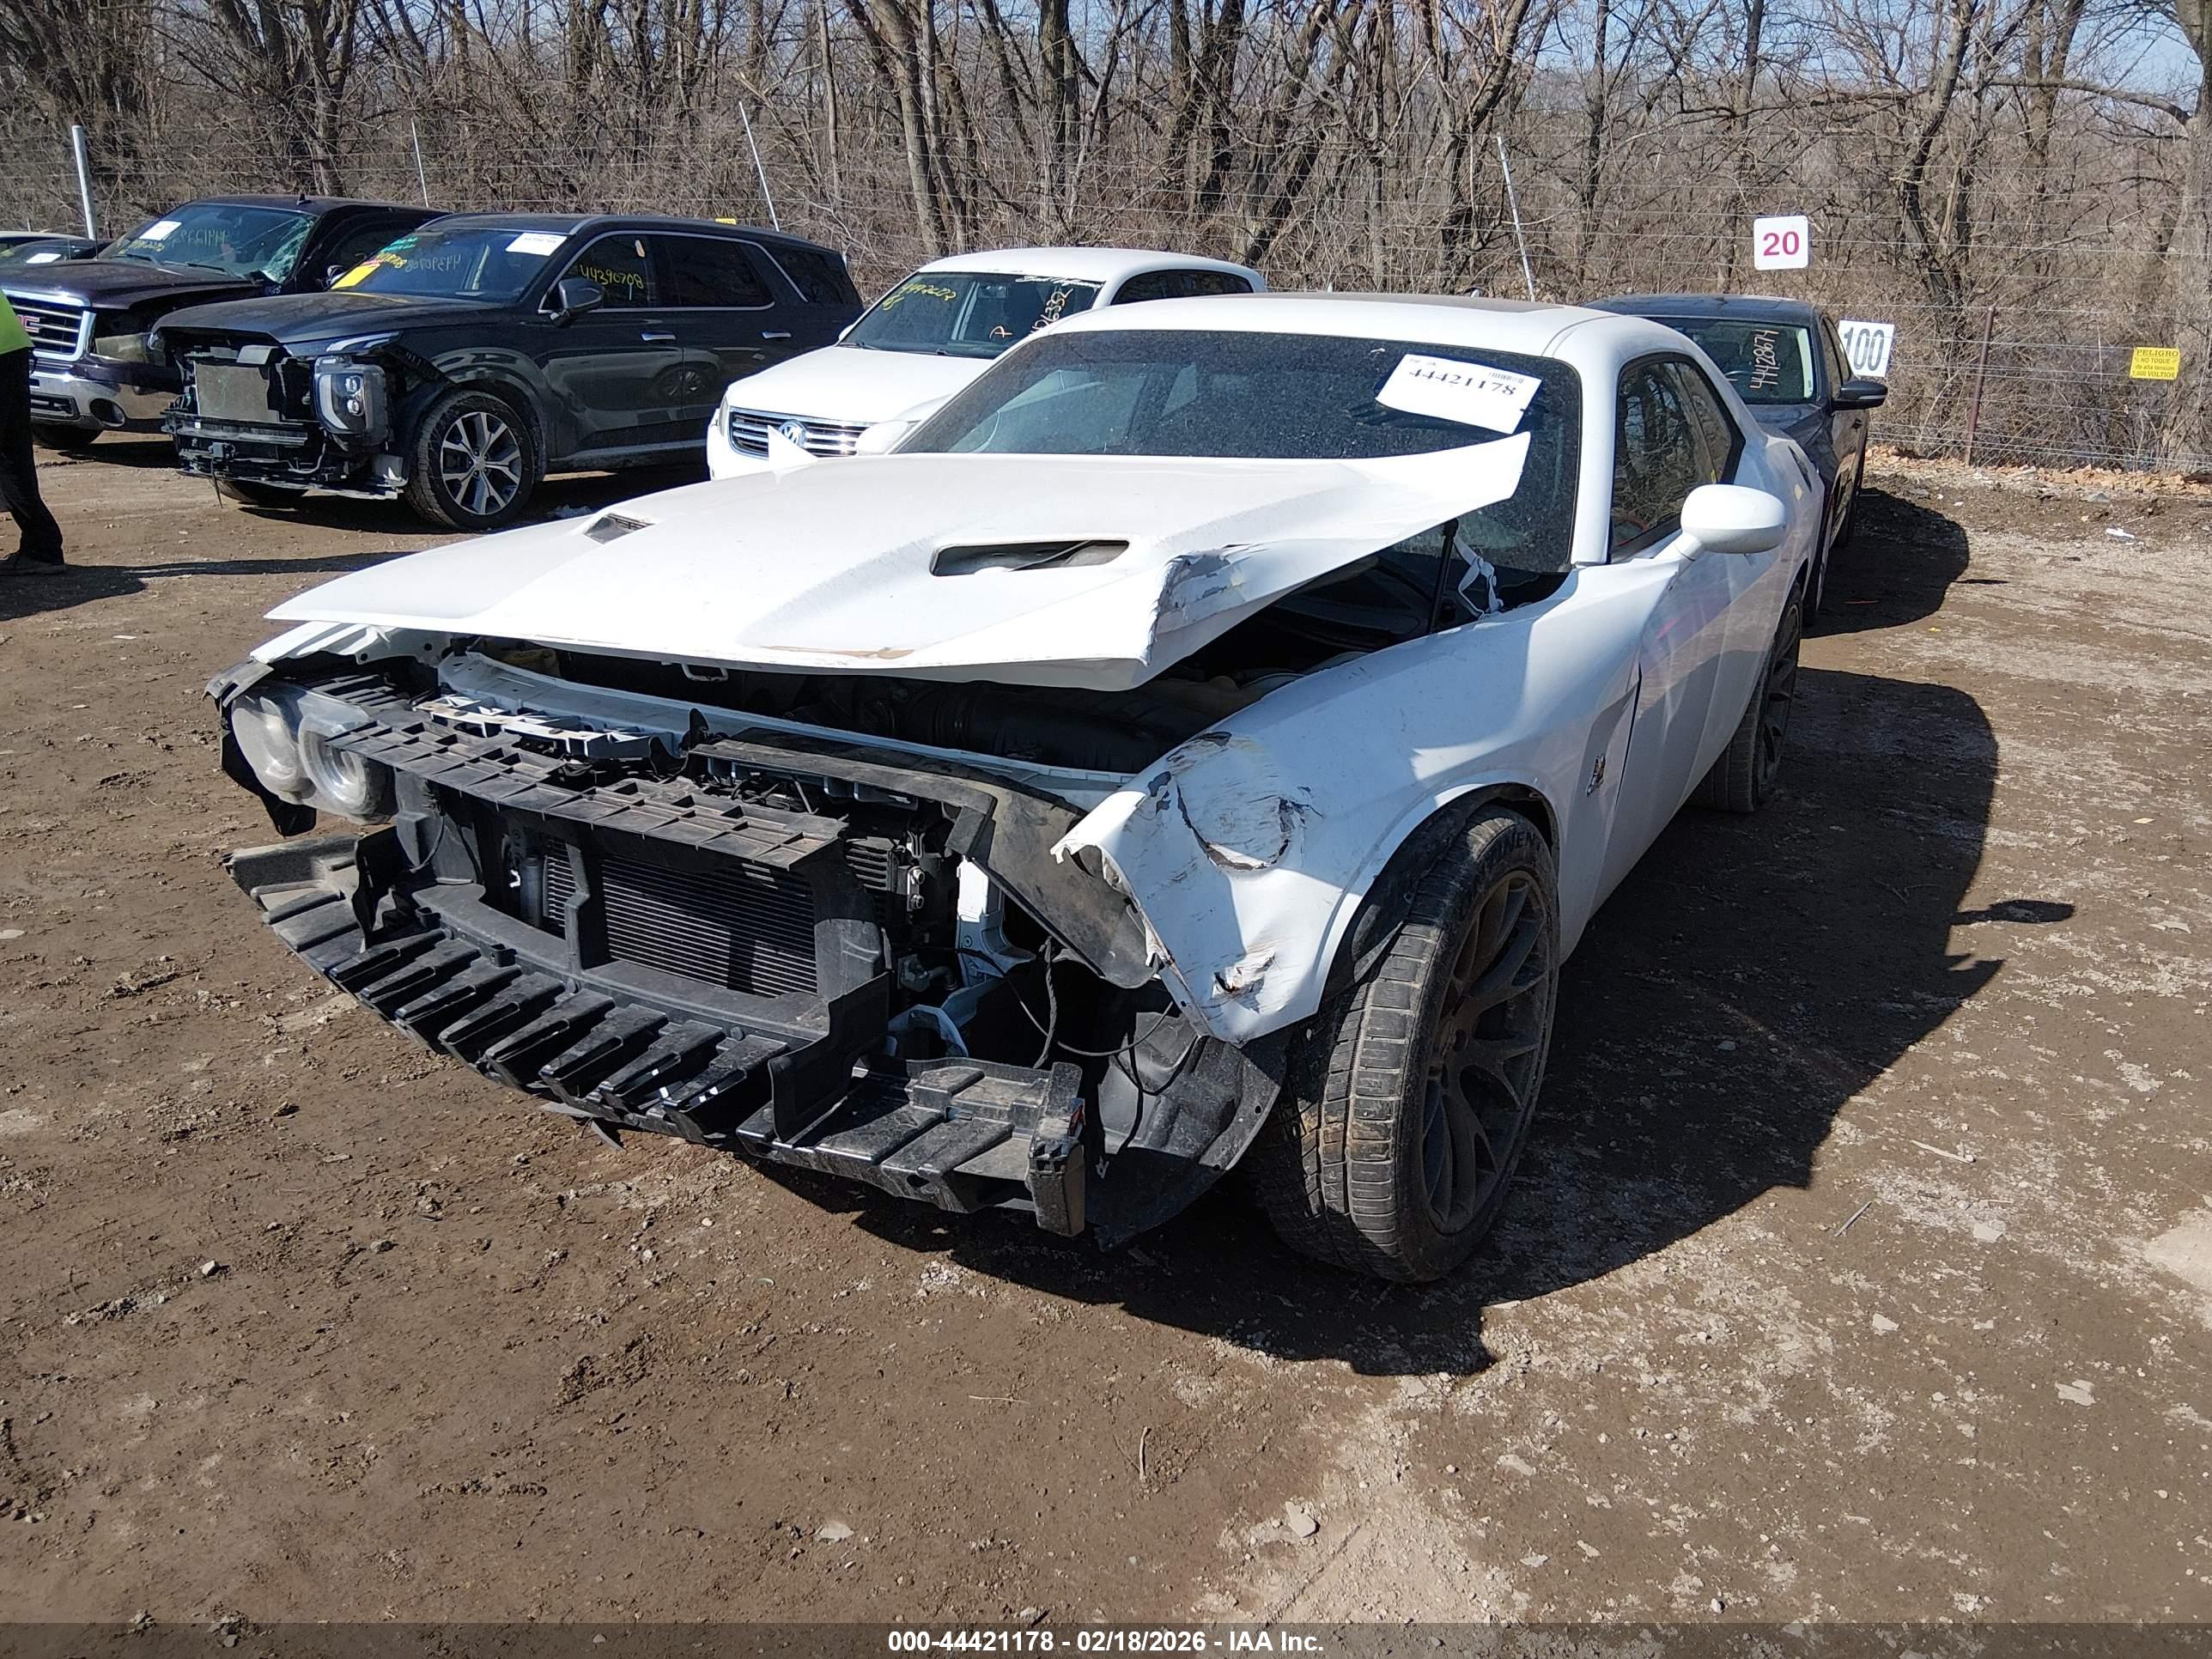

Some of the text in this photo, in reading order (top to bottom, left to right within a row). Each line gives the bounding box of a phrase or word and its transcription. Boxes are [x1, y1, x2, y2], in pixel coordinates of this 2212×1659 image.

[1763, 231, 1799, 256] 20
[580, 264, 644, 289] 44390708
[1749, 329, 1780, 388] 44428674
[1844, 327, 1884, 371] 100
[1409, 368, 1516, 395] 44421178
